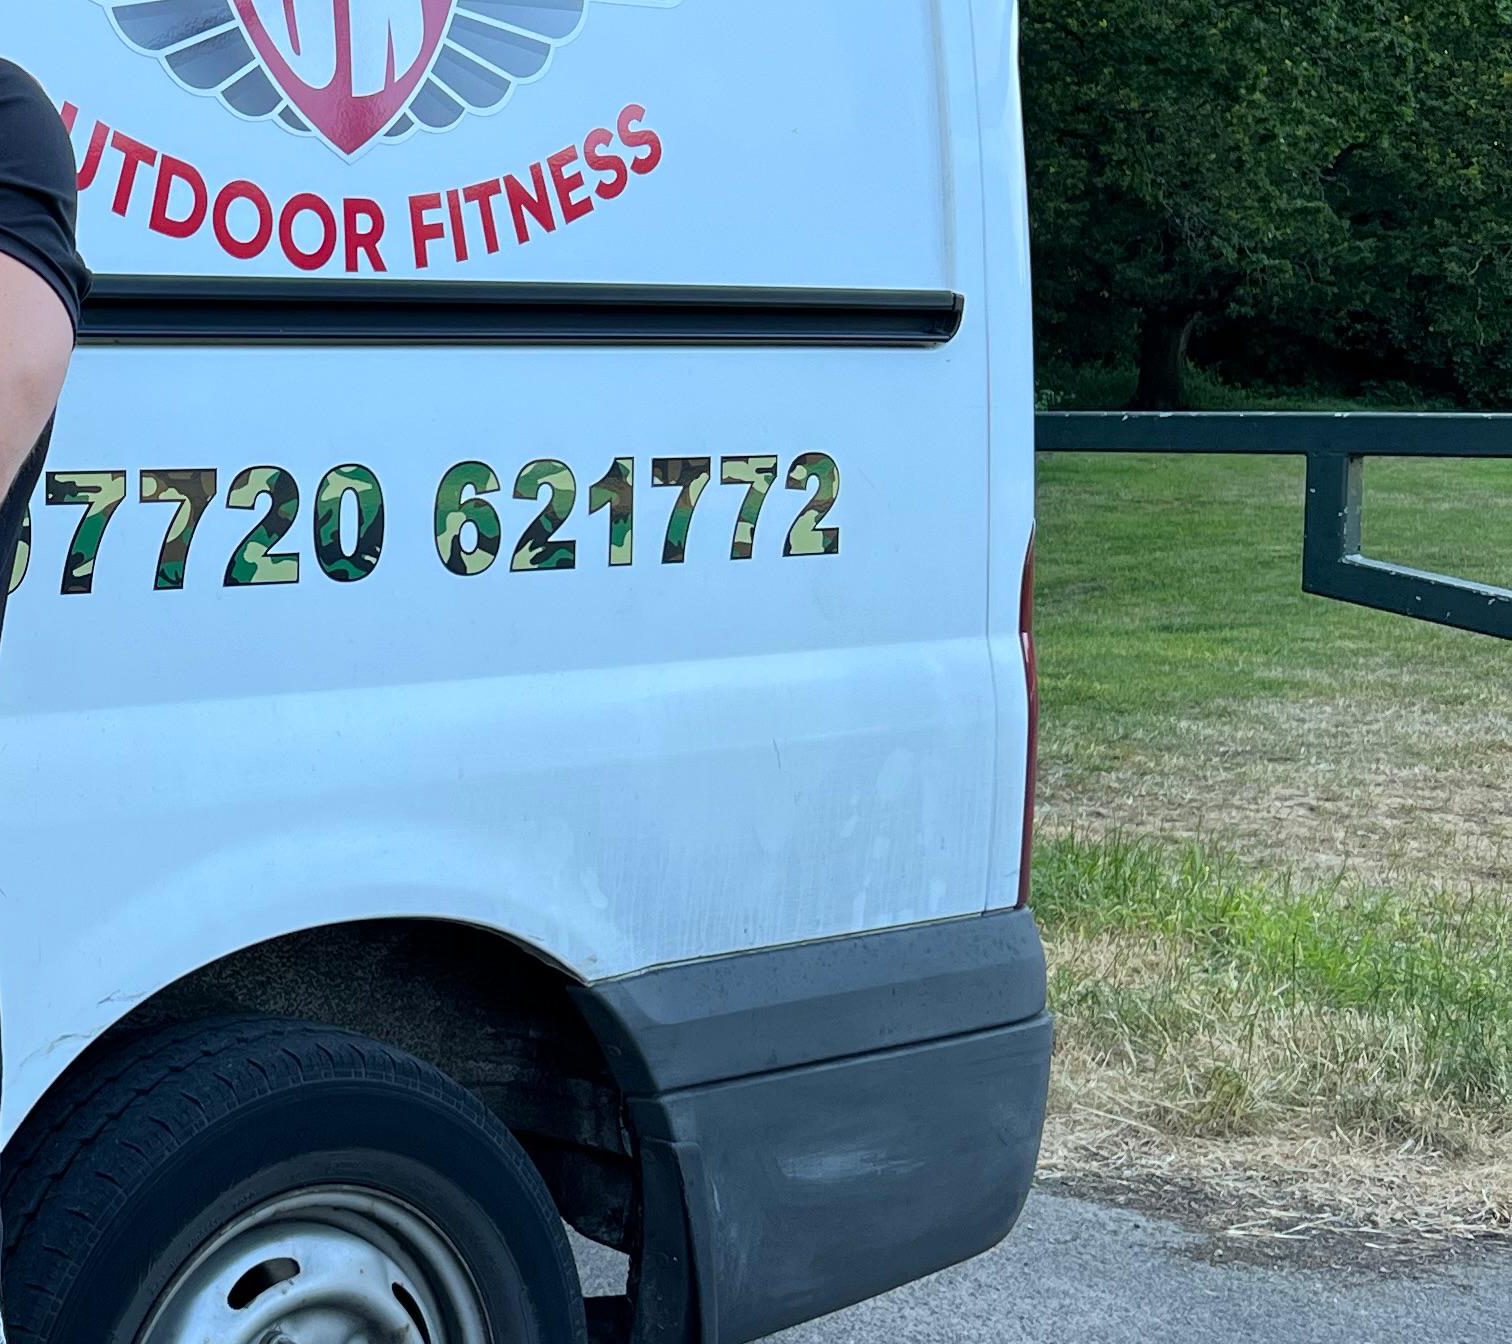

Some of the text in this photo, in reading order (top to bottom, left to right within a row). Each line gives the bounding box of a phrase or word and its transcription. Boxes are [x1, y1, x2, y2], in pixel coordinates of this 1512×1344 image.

[410, 102, 663, 270] FITNESS
[7, 452, 840, 596] 7720 621772
